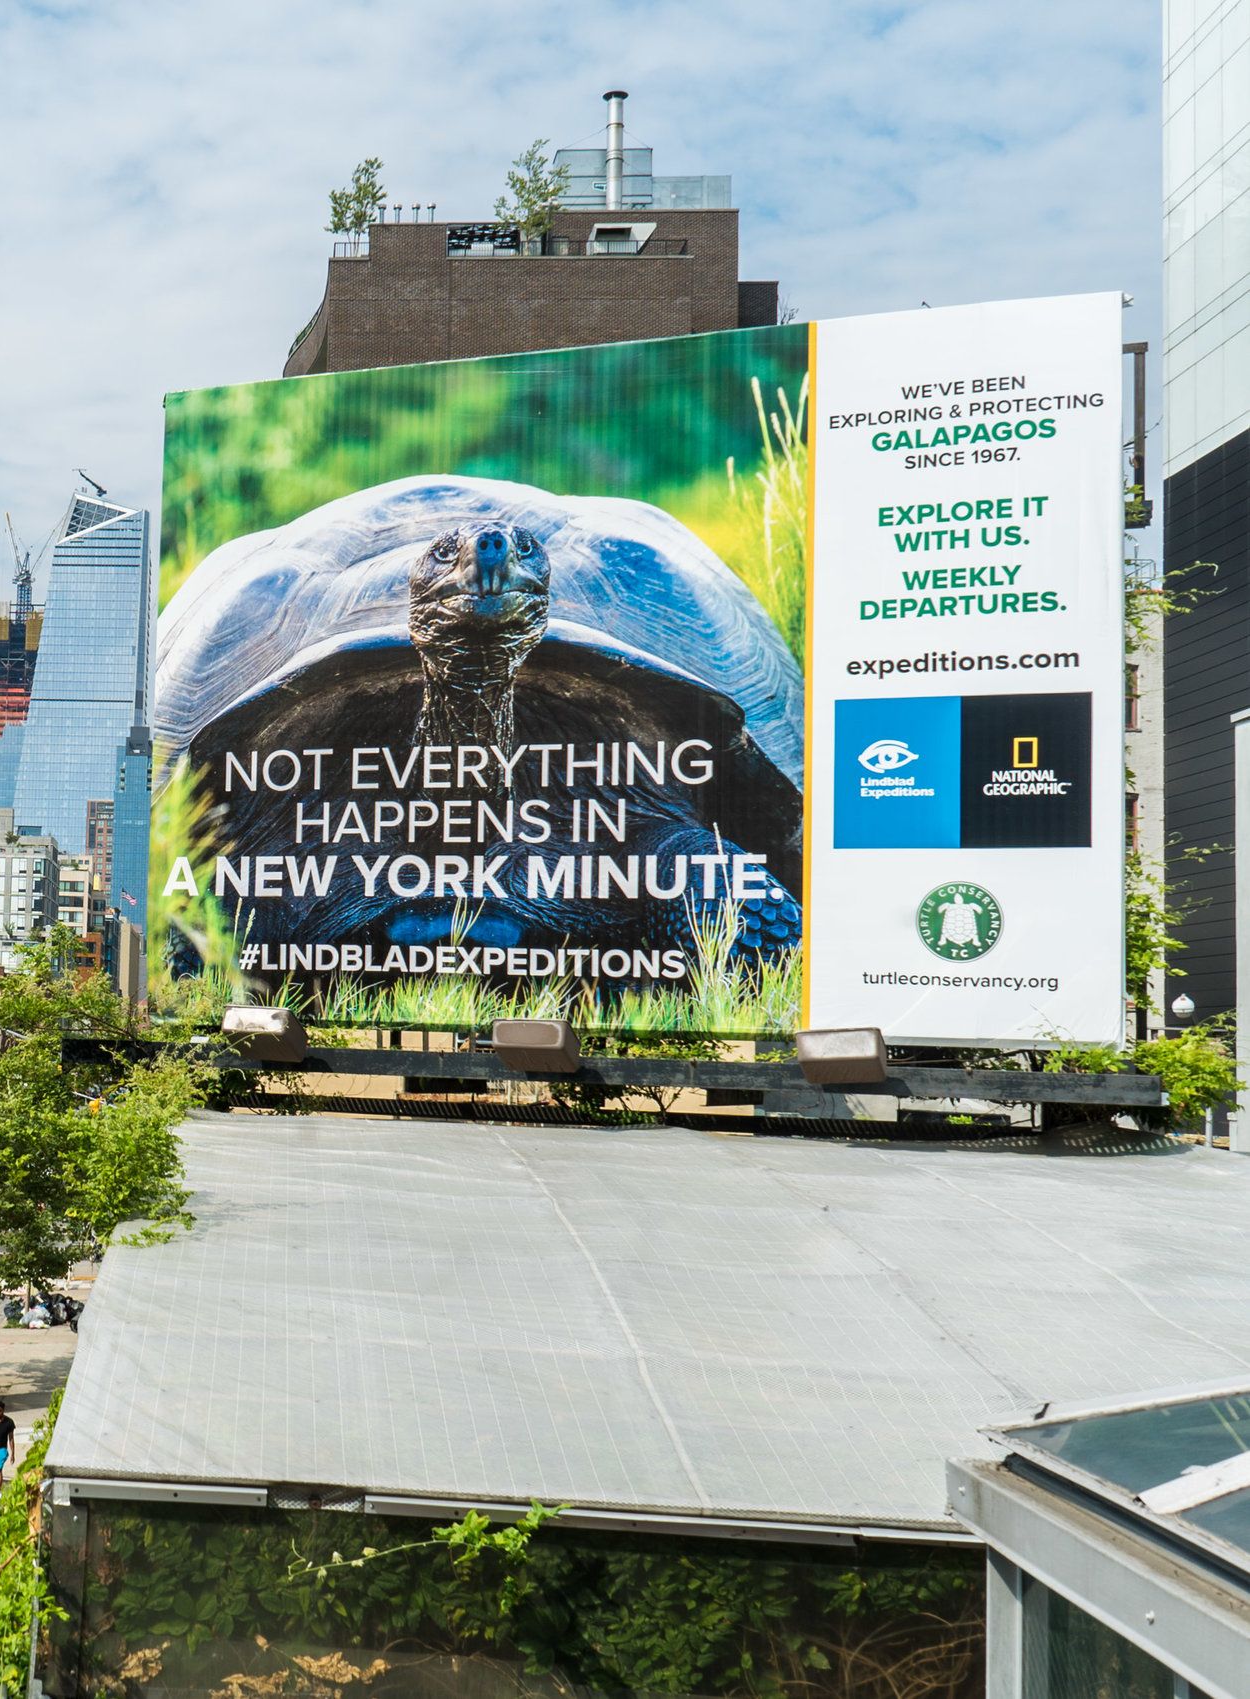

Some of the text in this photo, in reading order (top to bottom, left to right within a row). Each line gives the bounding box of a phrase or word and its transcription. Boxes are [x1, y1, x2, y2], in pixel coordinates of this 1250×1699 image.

[902, 376, 1025, 399] WE’VE BEEN
[830, 393, 1103, 429] EXPLORING & PROTECTING
[871, 418, 1056, 452] GALAPAGOS
[905, 447, 1020, 469] SINCE 1967.
[878, 496, 1048, 527] EXPLORE IT
[894, 526, 1029, 552] WITH US.
[902, 565, 1021, 590] WEEKLY
[860, 591, 1066, 620] DEPARTURES.
[847, 651, 1079, 679] expeditions.com
[225, 739, 714, 792] NOT EVERYTHING
[992, 769, 1057, 782] NATIONAL
[860, 776, 914, 787] Lindblad
[860, 787, 935, 799] Expeditions
[295, 798, 625, 844] HAPPENS IN
[162, 853, 785, 900] A NEW YORK MINUTE.
[920, 885, 1000, 945] TURTLE CONSERVANCY
[239, 944, 686, 979] #LINDBLADEXPEDITIONS
[951, 948, 969, 958] TC
[862, 972, 1059, 991] turtleconservancy.org
